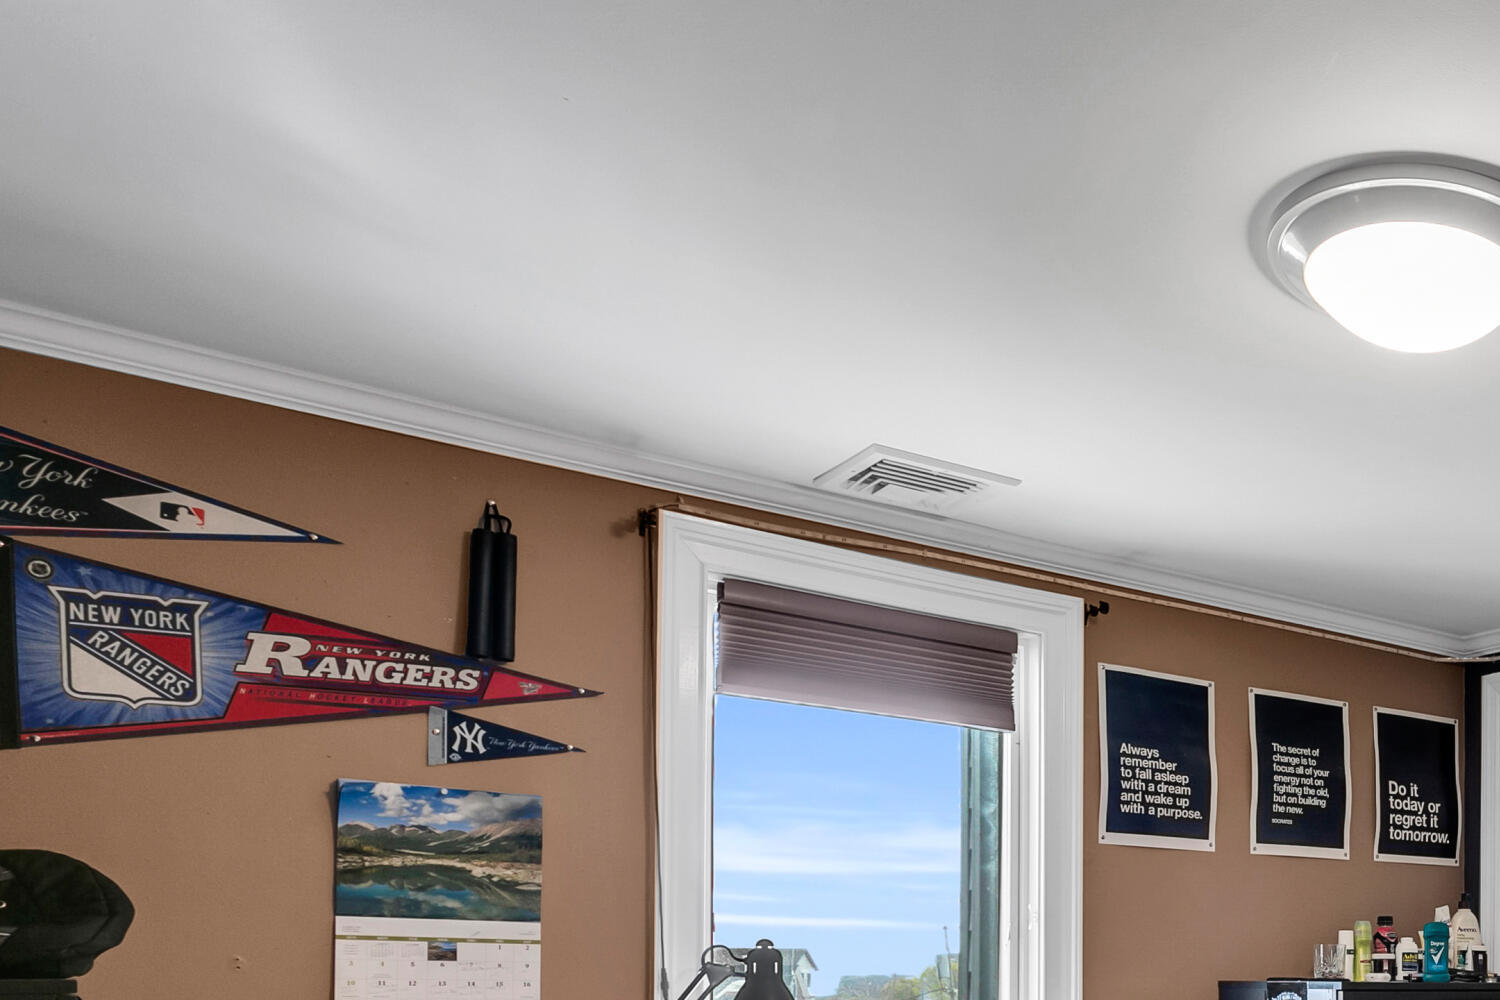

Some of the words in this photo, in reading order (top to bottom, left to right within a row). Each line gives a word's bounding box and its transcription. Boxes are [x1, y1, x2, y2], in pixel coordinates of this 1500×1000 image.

[18, 454, 98, 489] York
[0, 494, 80, 523] nkees
[69, 601, 121, 625] NEW
[129, 607, 191, 631] YORK
[235, 632, 481, 691] RANGERS
[316, 644, 362, 656] NEW
[375, 650, 431, 662] YORK
[87, 630, 191, 698] RANGERS
[1120, 742, 1160, 759] Always
[1272, 742, 1287, 752] The
[1287, 746, 1311, 756] secret
[1311, 748, 1320, 757] of
[1120, 757, 1177, 771] remember
[1272, 753, 1300, 765] change
[1300, 756, 1308, 765] is
[1308, 758, 1316, 766] to
[1120, 766, 1132, 778] to
[1135, 767, 1152, 779] fall
[1154, 771, 1189, 785] asleep
[1273, 763, 1295, 773] focus
[1295, 766, 1304, 774] all
[1304, 767, 1312, 775] of
[1313, 770, 1330, 778] your
[1120, 779, 1146, 791] with
[1147, 783, 1155, 792] a
[1156, 782, 1191, 796] dream
[1273, 774, 1300, 786] energy
[1300, 777, 1314, 785] not
[1388, 780, 1407, 796] Do
[1410, 782, 1419, 797] it
[1273, 783, 1302, 796] fighting
[1303, 786, 1316, 796] the
[1120, 791, 1142, 802] and
[1144, 793, 1174, 805] wake
[1176, 797, 1190, 809] up
[1273, 793, 1287, 803] but
[1287, 796, 1297, 804] on
[1298, 795, 1327, 808] building
[1389, 795, 1425, 814] today
[1428, 802, 1441, 813] or
[1120, 802, 1145, 814] with
[1148, 806, 1155, 815] a
[1157, 807, 1203, 820] purpose.
[1272, 804, 1285, 813] the
[1286, 806, 1303, 814] new.
[1389, 813, 1427, 829] regret
[1430, 814, 1439, 828] it
[1389, 826, 1450, 844] tomorrow.
